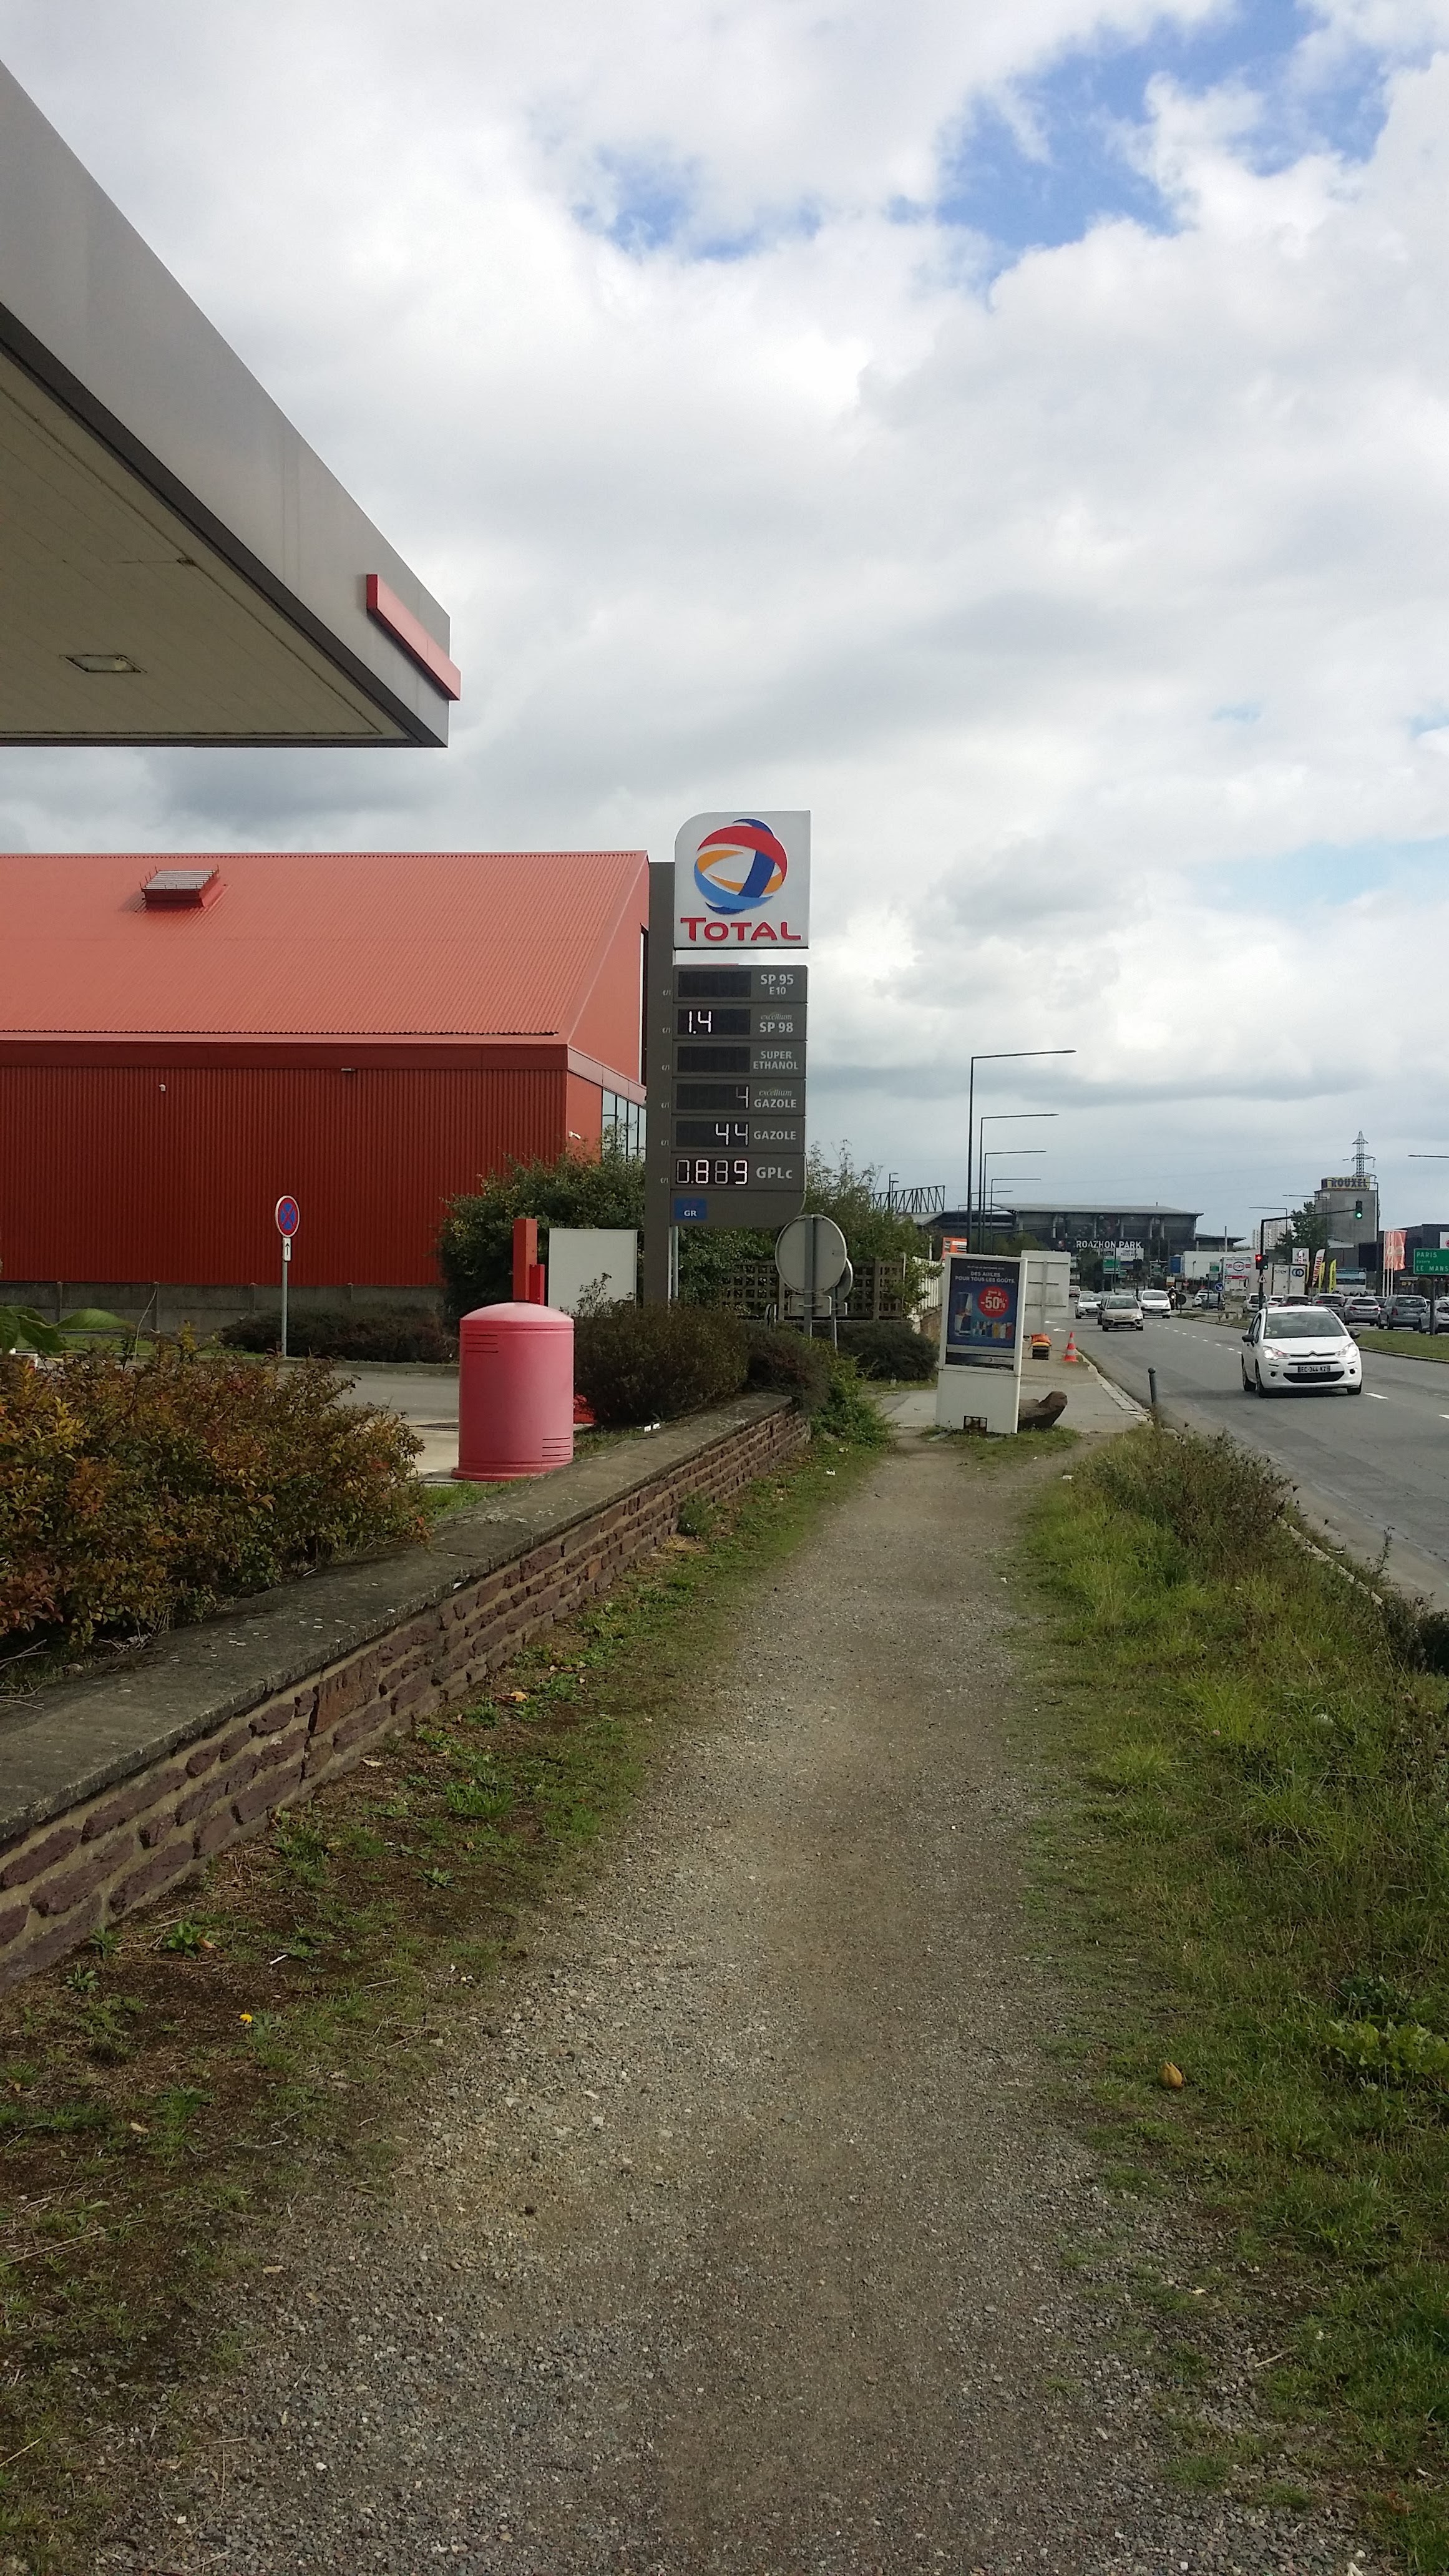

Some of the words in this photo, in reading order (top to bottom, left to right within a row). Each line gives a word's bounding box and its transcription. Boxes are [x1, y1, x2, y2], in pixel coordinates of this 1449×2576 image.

[680, 917, 801, 942] TOTAL
[760, 974, 776, 985] SP
[779, 974, 794, 985] 95
[761, 1012, 793, 1020] excellium
[759, 1022, 776, 1033] SP
[778, 1022, 794, 1033] 98
[761, 1051, 792, 1060] SUPER
[753, 1061, 799, 1070] ETHANOL
[759, 1089, 792, 1097] excellium
[754, 1099, 797, 1108] GAZOLE
[753, 1131, 797, 1140] GAZOLE
[756, 1167, 793, 1179] GPLc
[1076, 1241, 1116, 1249] ROAZHON
[1119, 1241, 1142, 1249] PARK
